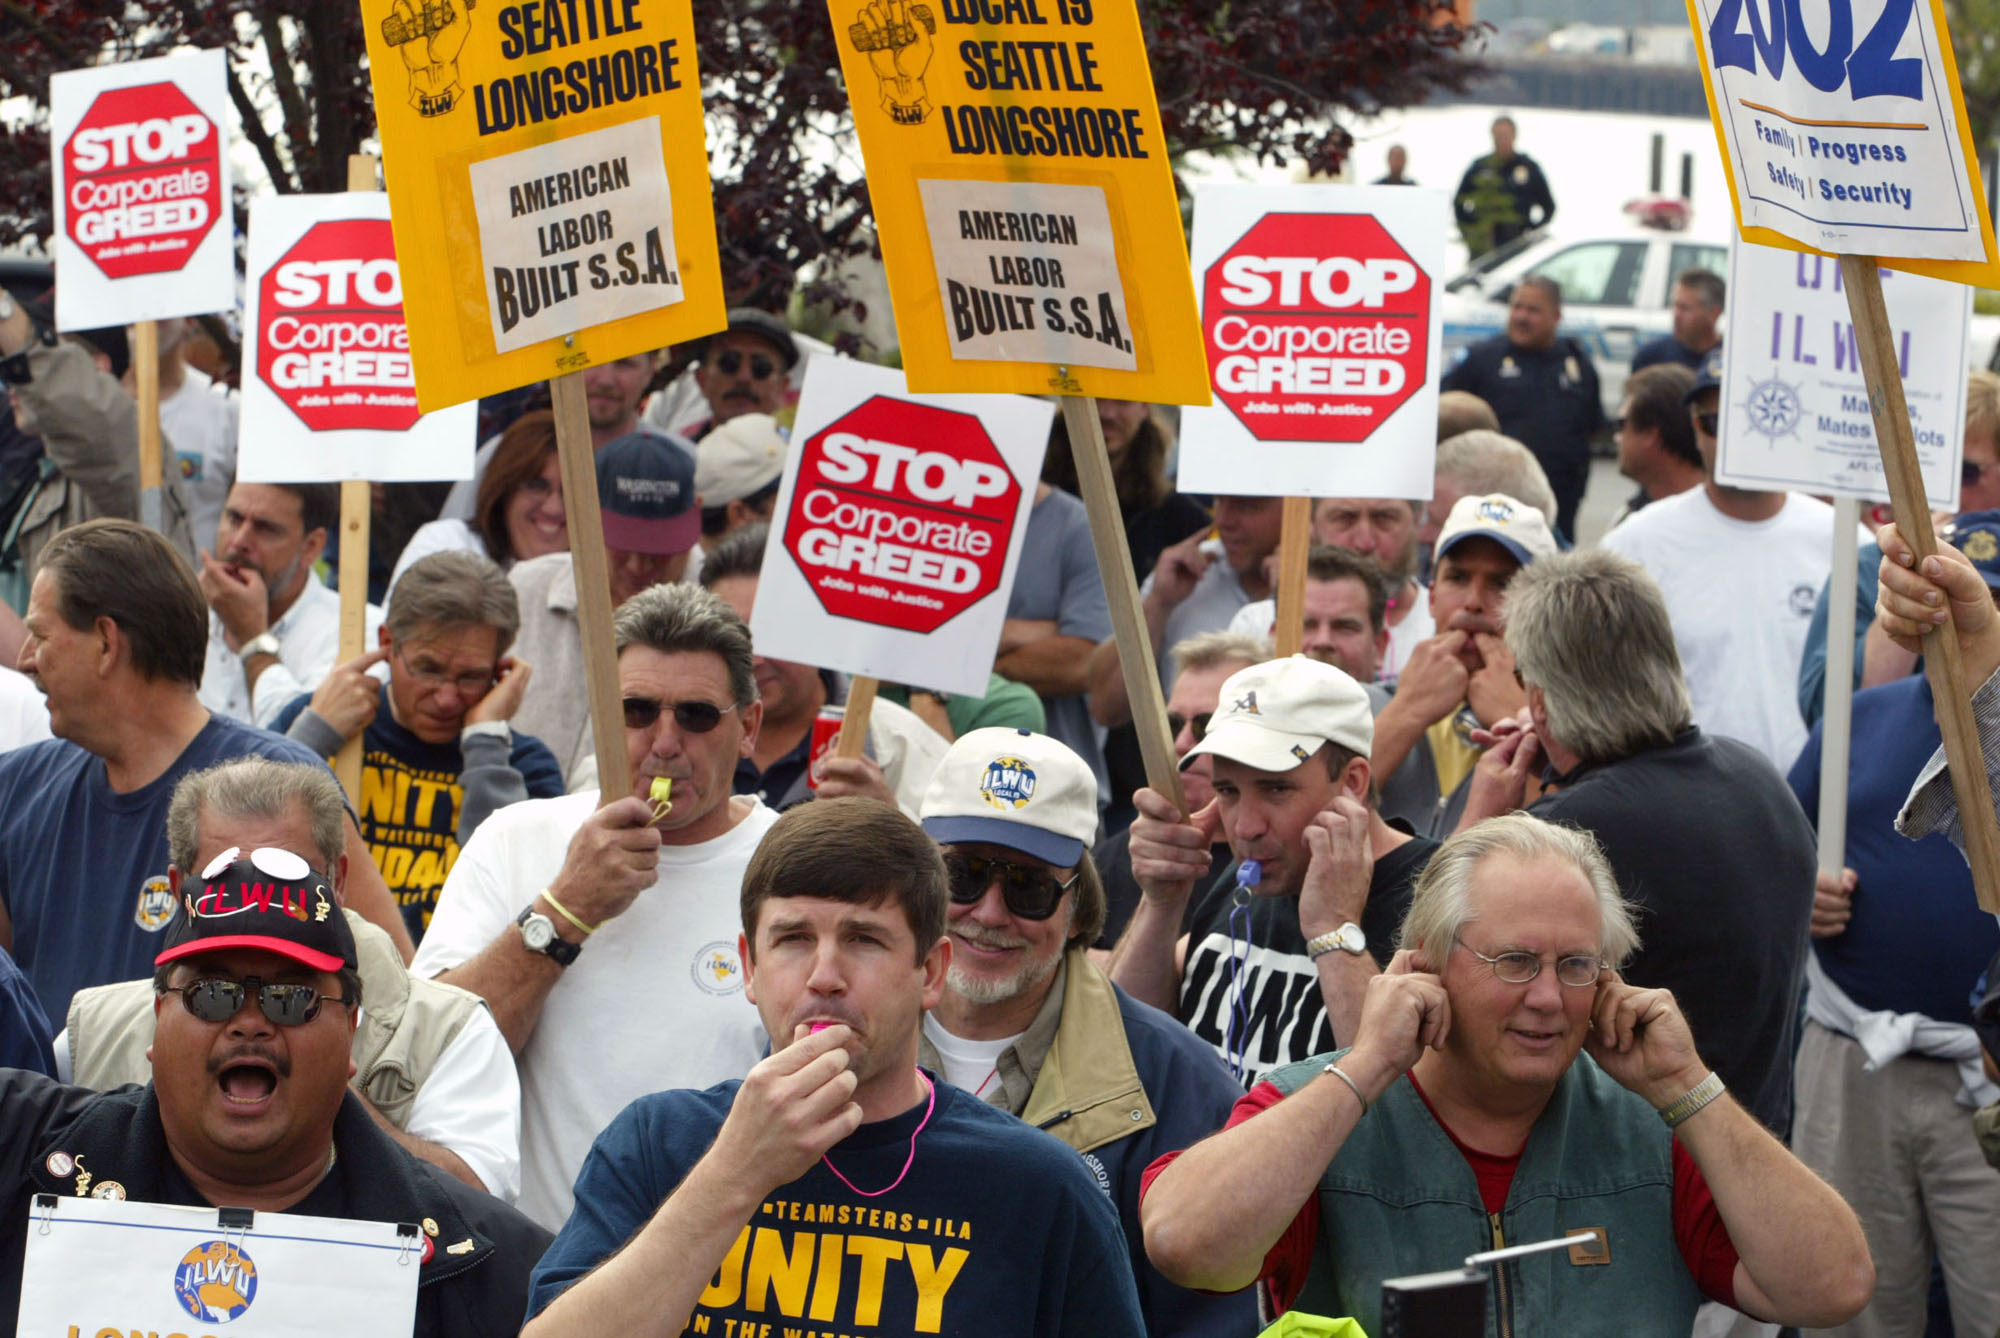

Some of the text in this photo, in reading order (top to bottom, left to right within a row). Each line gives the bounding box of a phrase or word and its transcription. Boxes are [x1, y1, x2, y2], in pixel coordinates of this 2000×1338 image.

[473, 39, 682, 137] LONGSHORE
[959, 40, 1103, 92] SEATTLE
[73, 113, 209, 172] STOP
[941, 105, 1149, 159] LONGSHORE
[1755, 119, 1907, 165] Family Progress
[71, 167, 209, 211] Corporate
[509, 156, 631, 218] AMERICAN
[1767, 161, 1912, 210] Safety Security
[75, 198, 209, 245] GREED
[538, 209, 614, 258] LABOR
[958, 209, 1079, 246] AMERICAN
[273, 258, 404, 308] STO
[493, 226, 678, 335] BUILT S.S.A.
[989, 255, 1066, 289] LABOR
[1220, 255, 1418, 308] STOP
[267, 316, 410, 354] Corpora
[946, 278, 1132, 354] BUILT S.S.A.
[1213, 315, 1412, 359] Corporate
[270, 351, 416, 389] GREE
[1215, 354, 1406, 397] GREED
[1243, 401, 1373, 417] Jobs with Justice
[816, 432, 1010, 509] STOP
[802, 488, 993, 557] Corporate
[798, 528, 981, 594] GREED
[819, 574, 944, 610] Jobs with Justice
[983, 769, 1035, 797] ILWU
[706, 960, 737, 974] ILWU
[777, 1200, 972, 1240] TEAMSTERS ILA
[184, 1258, 249, 1298] ILWU
